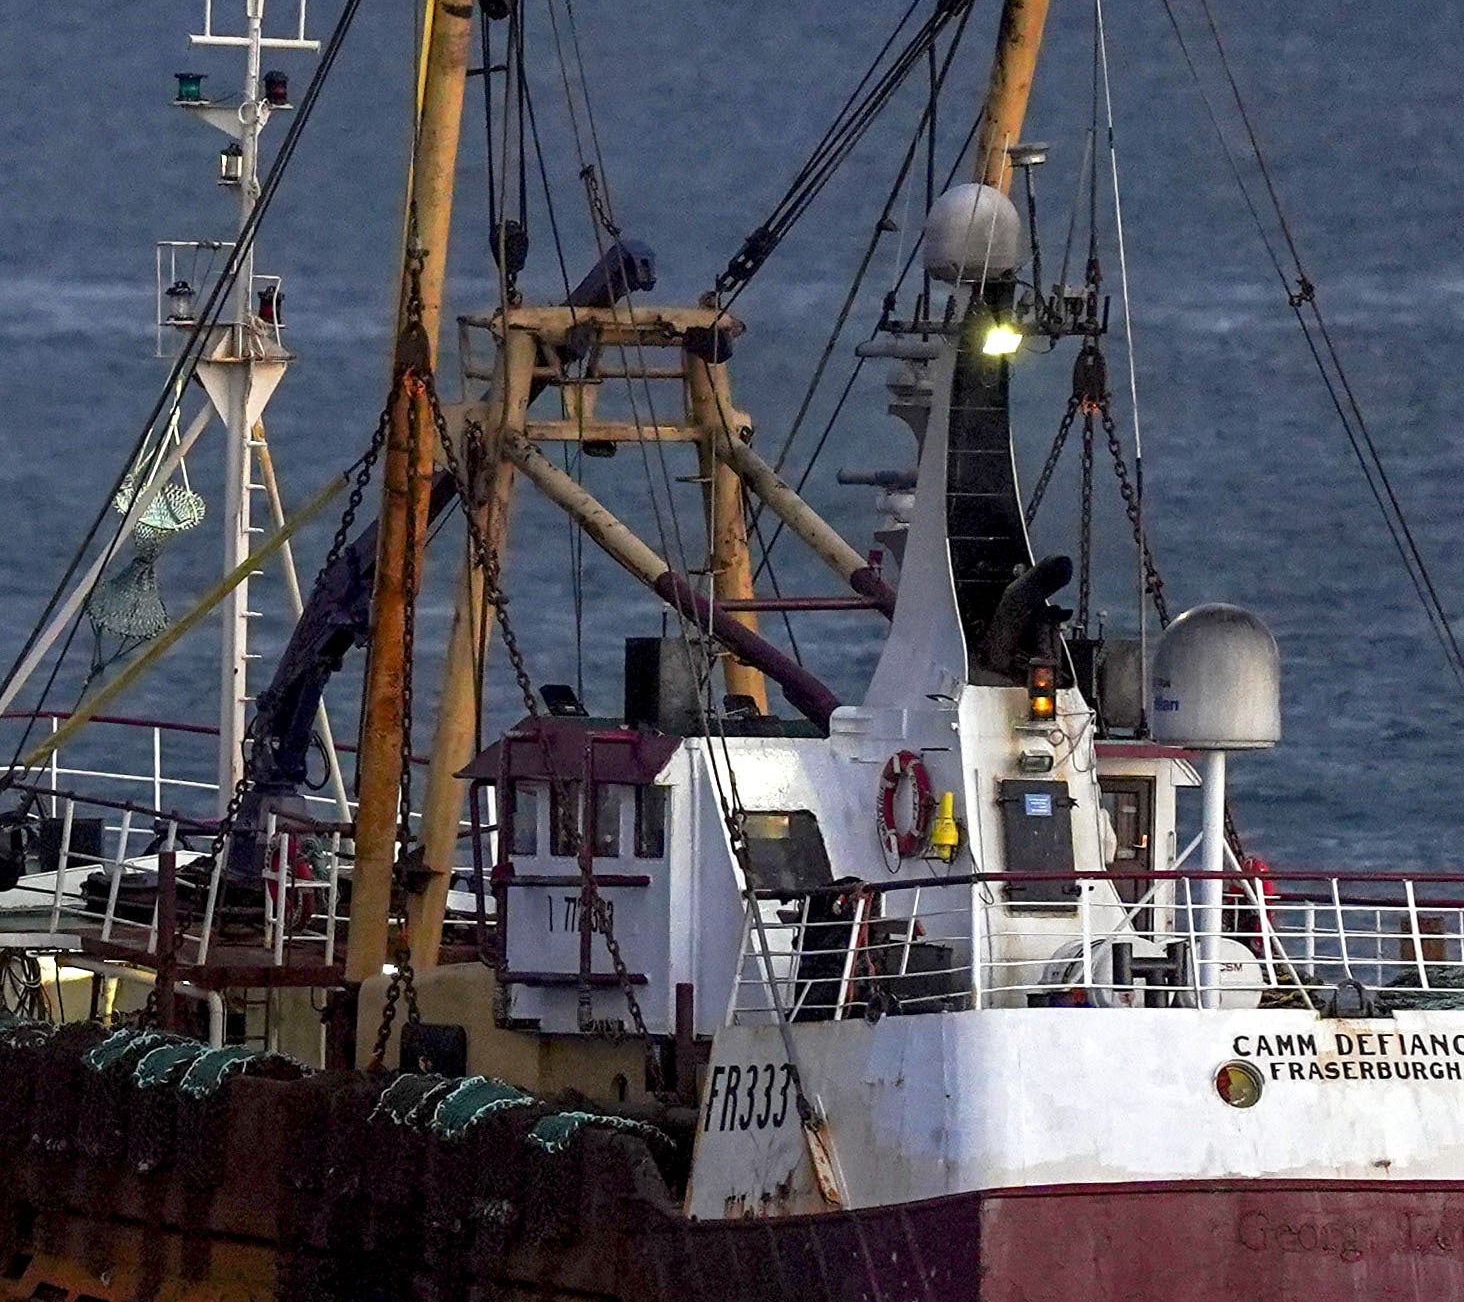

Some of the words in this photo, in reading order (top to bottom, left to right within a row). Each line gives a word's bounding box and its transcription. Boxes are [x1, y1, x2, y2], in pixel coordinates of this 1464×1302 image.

[1232, 1034, 1318, 1057] CAMM
[1270, 1061, 1463, 1081] FRASERBURGH
[704, 1062, 790, 1132] FR333
